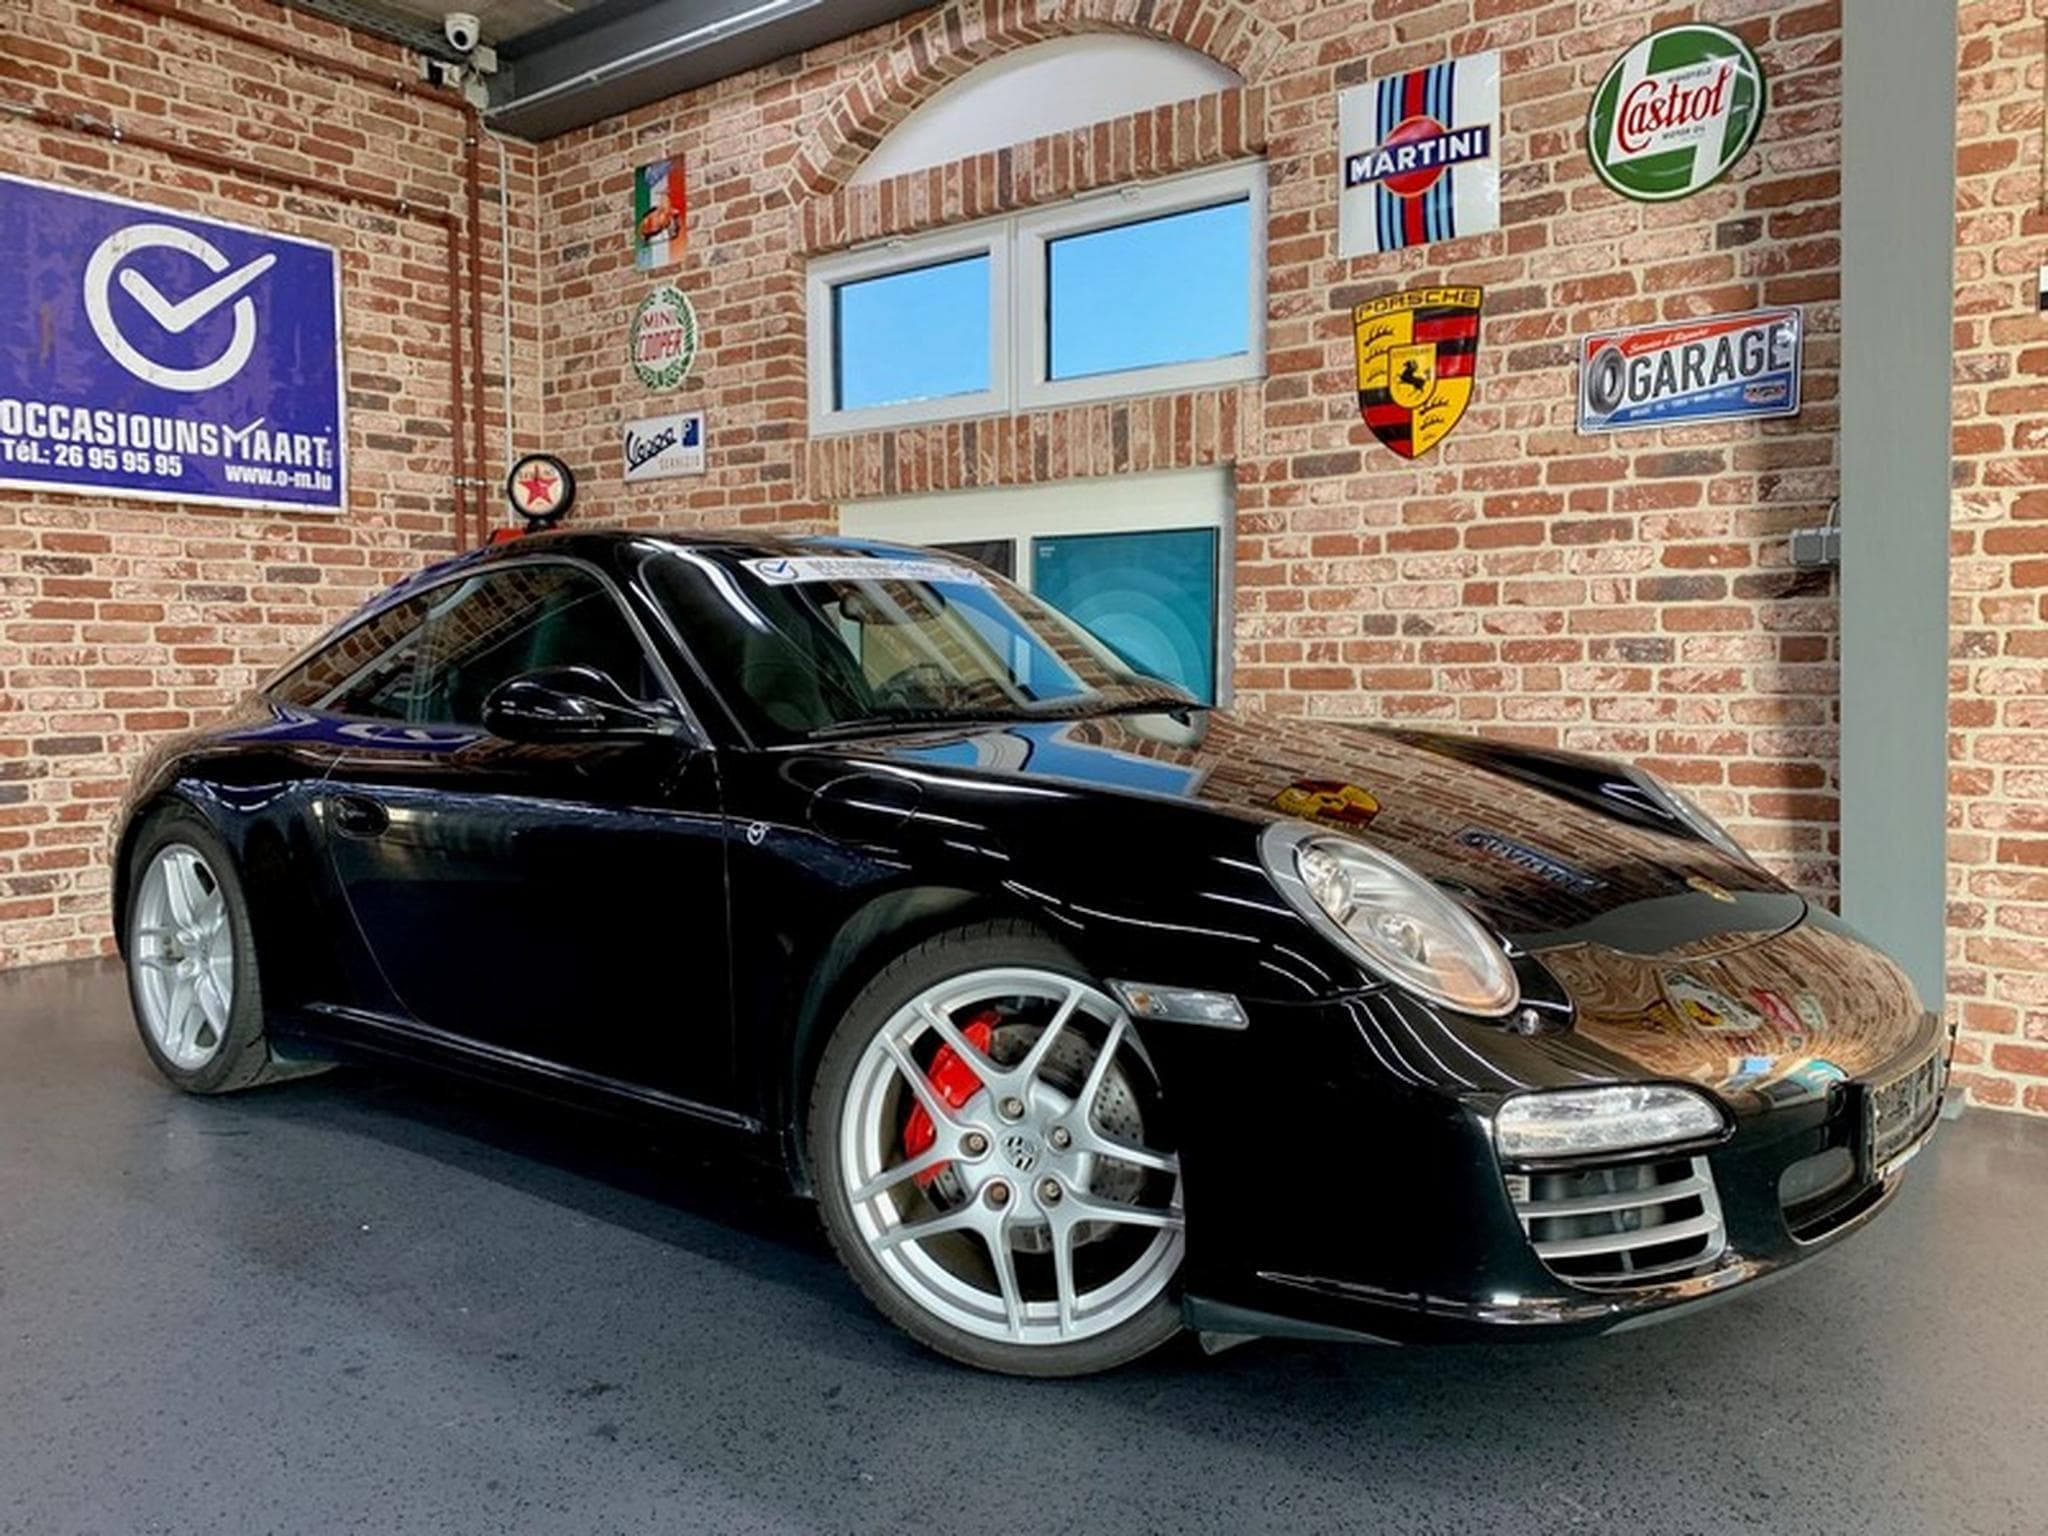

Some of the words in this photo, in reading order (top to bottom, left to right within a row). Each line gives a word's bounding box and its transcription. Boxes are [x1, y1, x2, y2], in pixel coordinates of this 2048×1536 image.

[1616, 63, 1733, 155] Castrol
[1350, 130, 1483, 183] MARTINI
[1358, 289, 1478, 319] PORSCHE
[1628, 319, 1793, 403] GARAGE
[54, 443, 84, 468] 26
[88, 446, 118, 472] 95
[122, 450, 150, 475] 95
[155, 453, 182, 478] 95
[224, 464, 333, 491] www.o-m.lu
